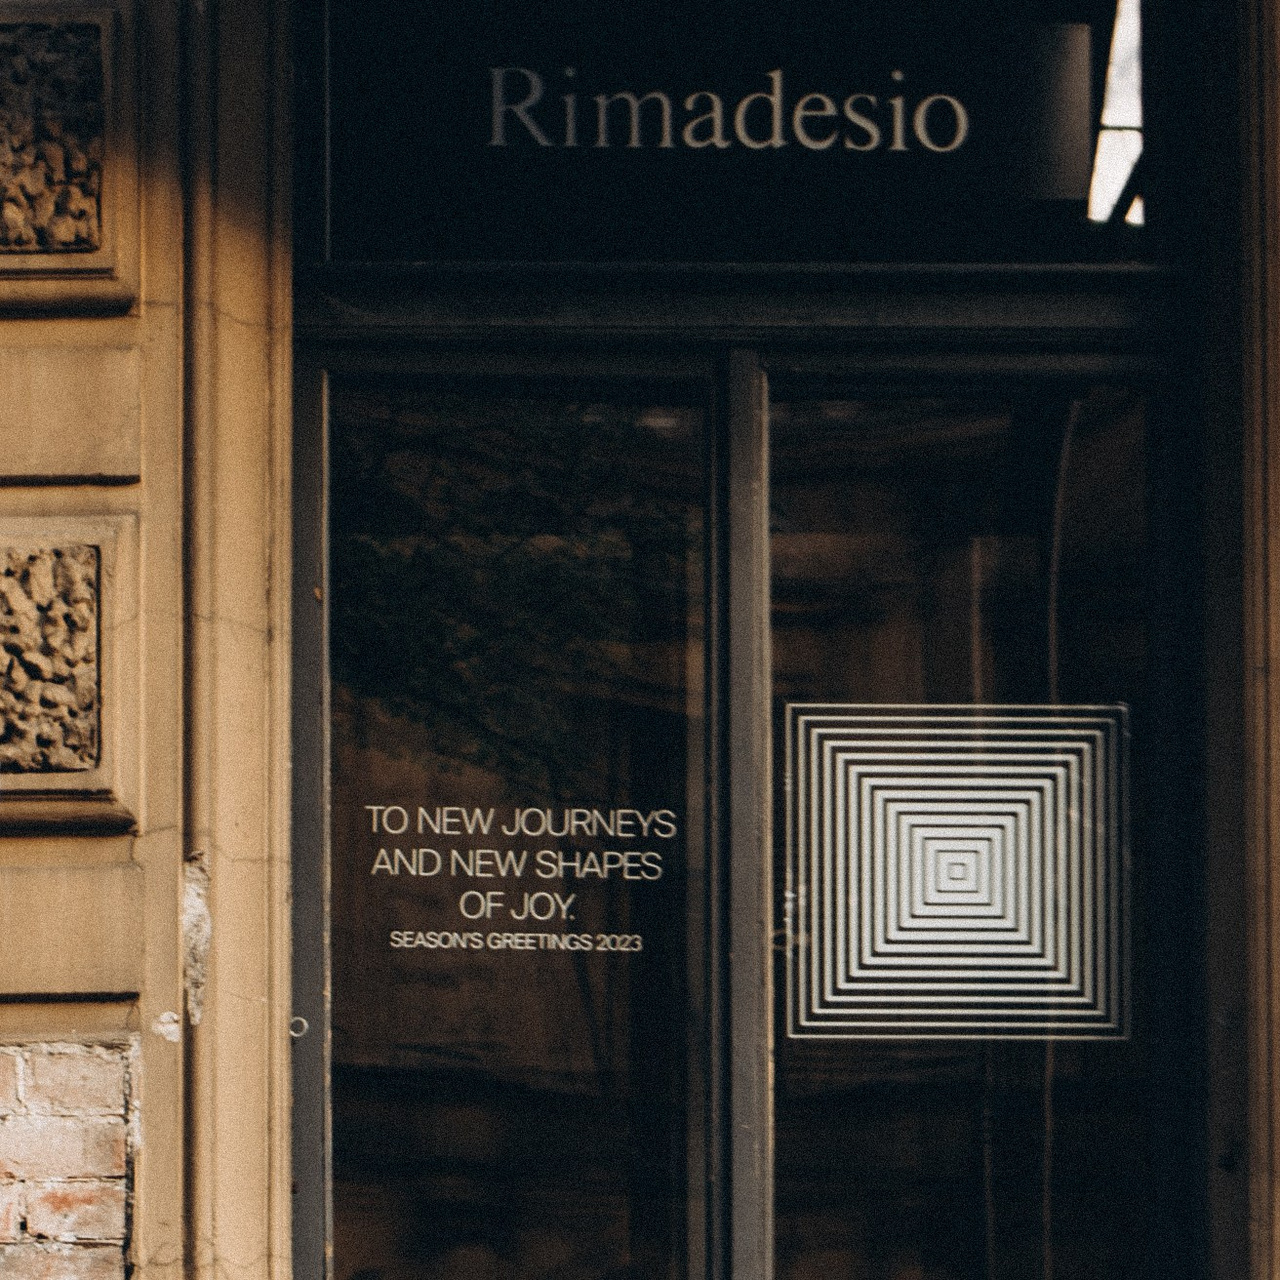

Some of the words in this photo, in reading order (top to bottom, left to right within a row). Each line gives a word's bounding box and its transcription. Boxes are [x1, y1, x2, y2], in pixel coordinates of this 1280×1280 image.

[488, 67, 970, 153] Rimadesio
[365, 805, 409, 835] TO
[417, 806, 495, 836] NEW
[501, 807, 677, 838] JOURNEYS
[371, 848, 442, 877] AND
[450, 849, 527, 878] NEW
[535, 850, 663, 881] SHAPES
[459, 890, 505, 920] OF
[510, 891, 578, 921] JOY.
[390, 930, 484, 949] SEASON'S
[486, 932, 593, 951] GREETINGS
[596, 934, 643, 952] 2023
